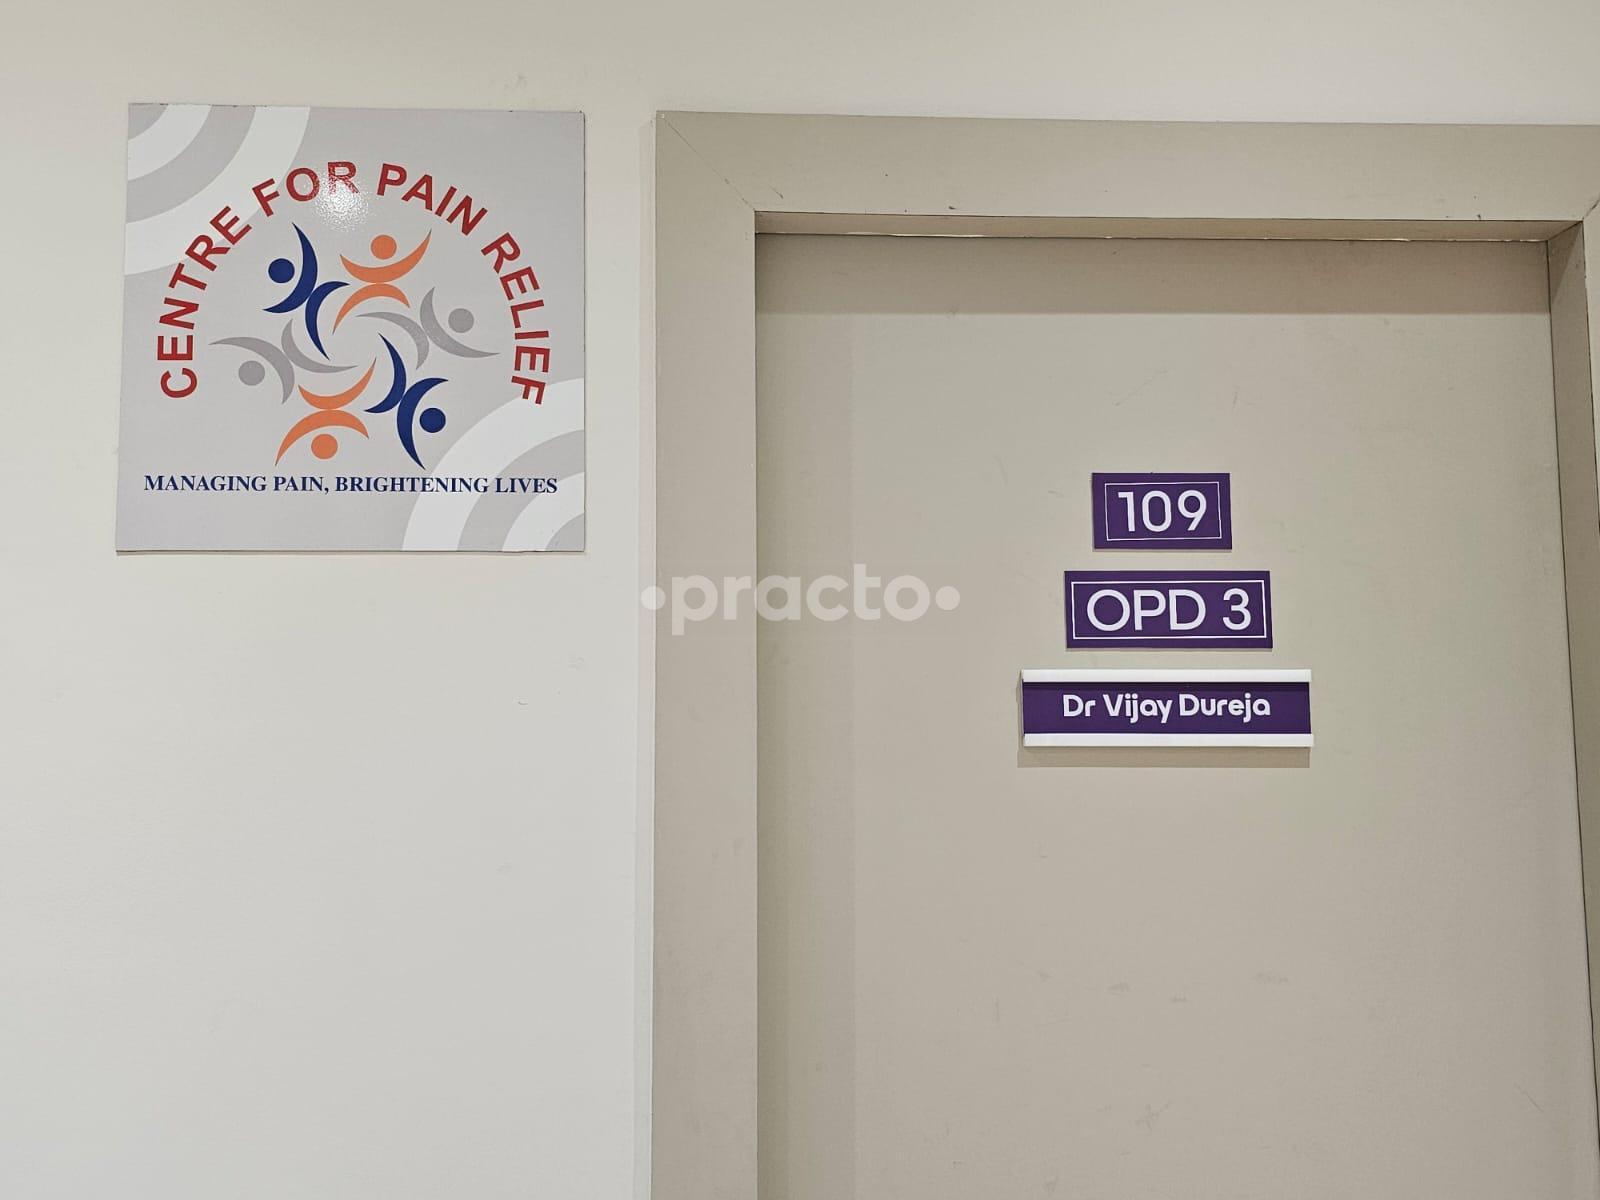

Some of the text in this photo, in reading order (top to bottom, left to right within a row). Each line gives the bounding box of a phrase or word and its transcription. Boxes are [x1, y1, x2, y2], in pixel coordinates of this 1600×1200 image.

[157, 160, 551, 405] CENTRE FOR PAIN RELIEF
[144, 475, 558, 495] MANAGING PAIN, BRIGHTENING LIVES
[1117, 489, 1207, 533] 109
[1086, 587, 1252, 632] OPD 3
[1062, 692, 1271, 724] Dr Vijay Dureja
